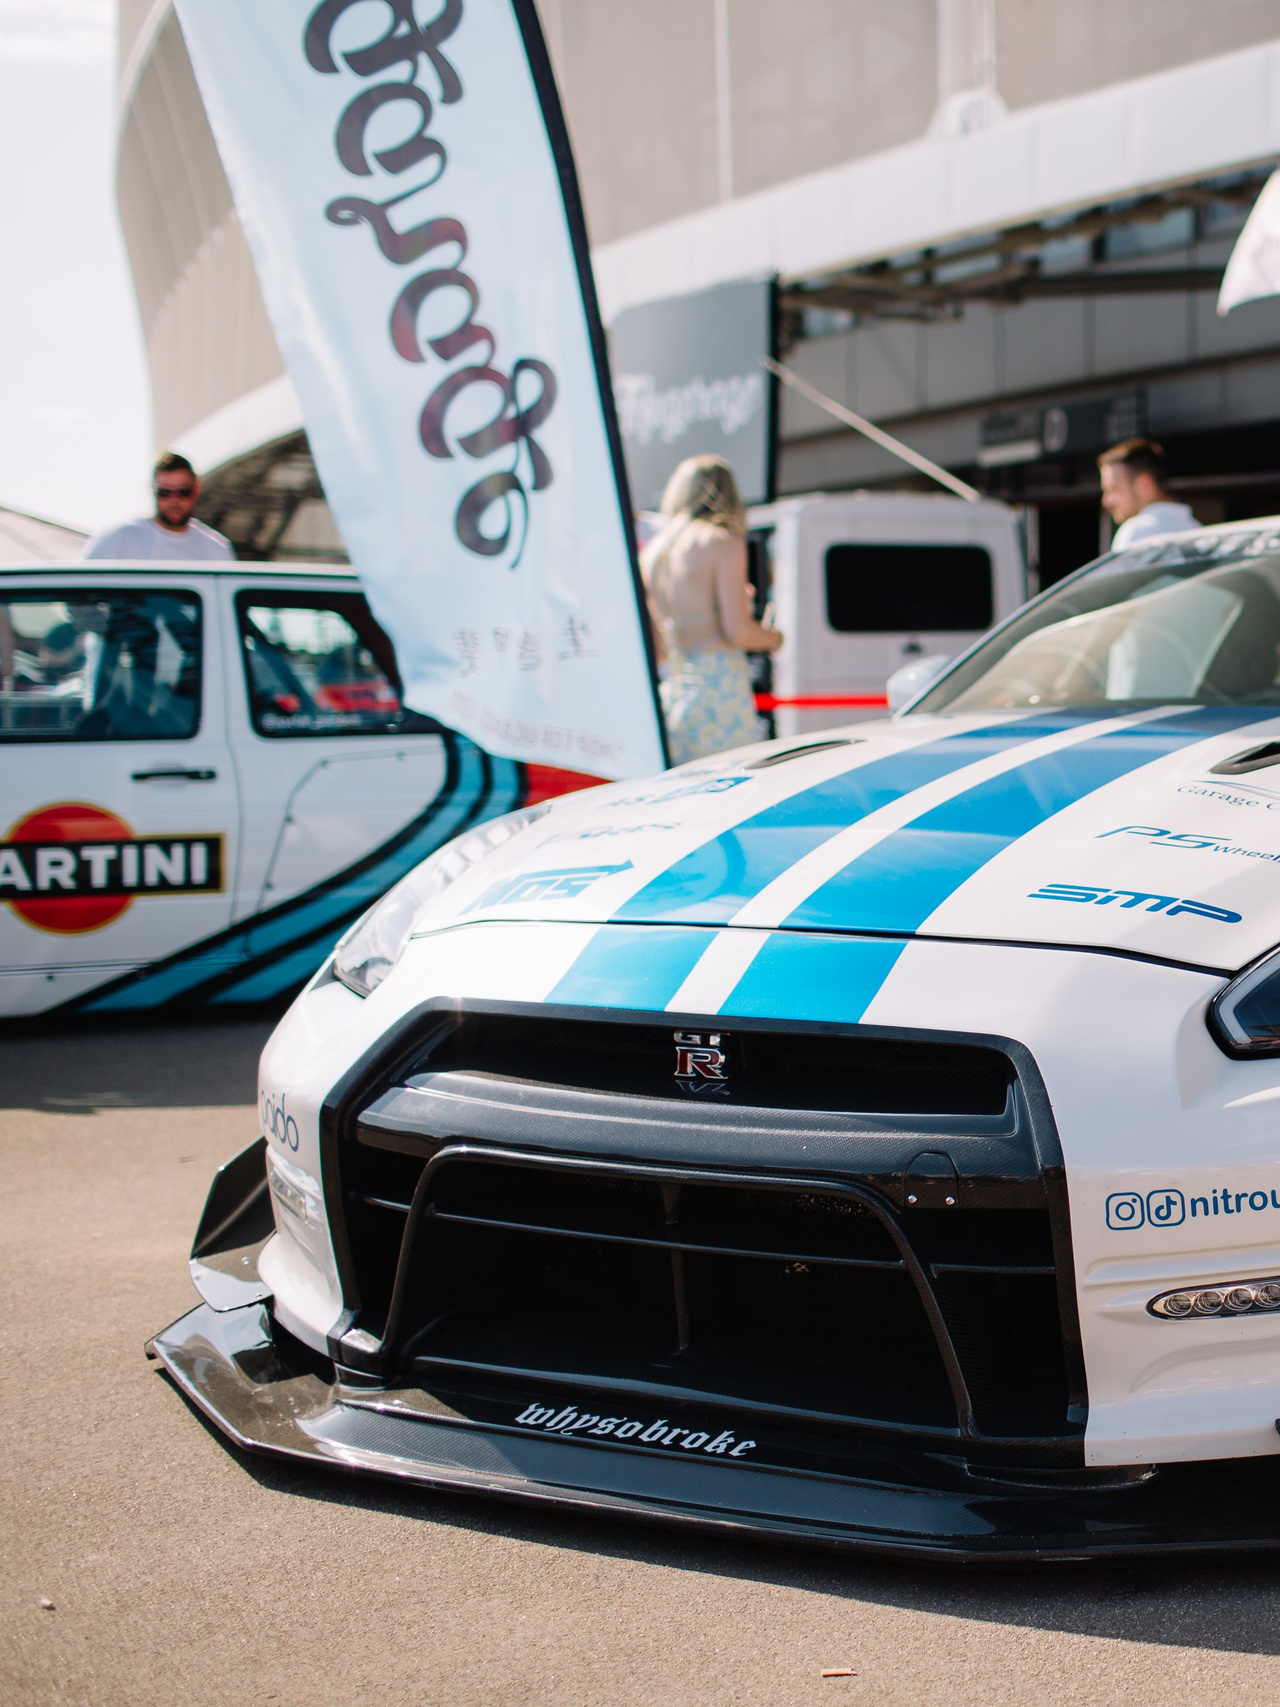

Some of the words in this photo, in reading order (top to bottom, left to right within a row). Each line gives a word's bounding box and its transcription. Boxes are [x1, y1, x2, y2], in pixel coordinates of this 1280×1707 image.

[1177, 784, 1260, 806] Garage
[1094, 825, 1233, 849] PS
[1027, 883, 1242, 924] SMP
[514, 1402, 756, 1457] whysobroke
